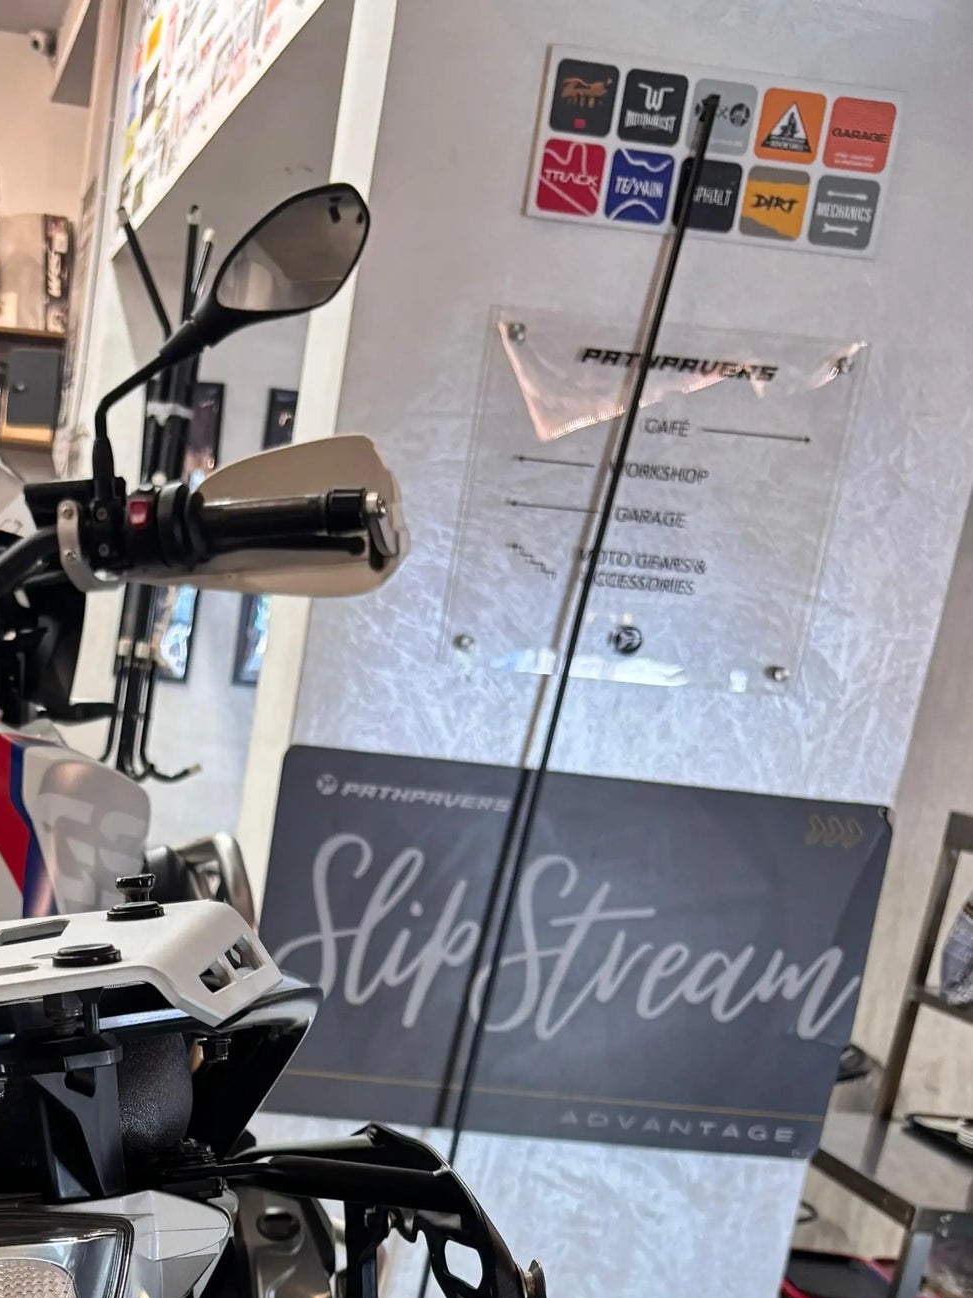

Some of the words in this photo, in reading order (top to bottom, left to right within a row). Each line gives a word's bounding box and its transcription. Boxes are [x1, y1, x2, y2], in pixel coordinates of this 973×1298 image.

[831, 127, 891, 144] GARAGE
[544, 169, 599, 188] TRACK
[750, 194, 798, 213] DIRT
[814, 200, 873, 223] MECHANICS
[614, 506, 688, 529] GARAGE
[583, 569, 696, 596] CCESSORIES
[340, 781, 514, 814] PATHPAVERS
[559, 1109, 796, 1144] ADVANTAGE
